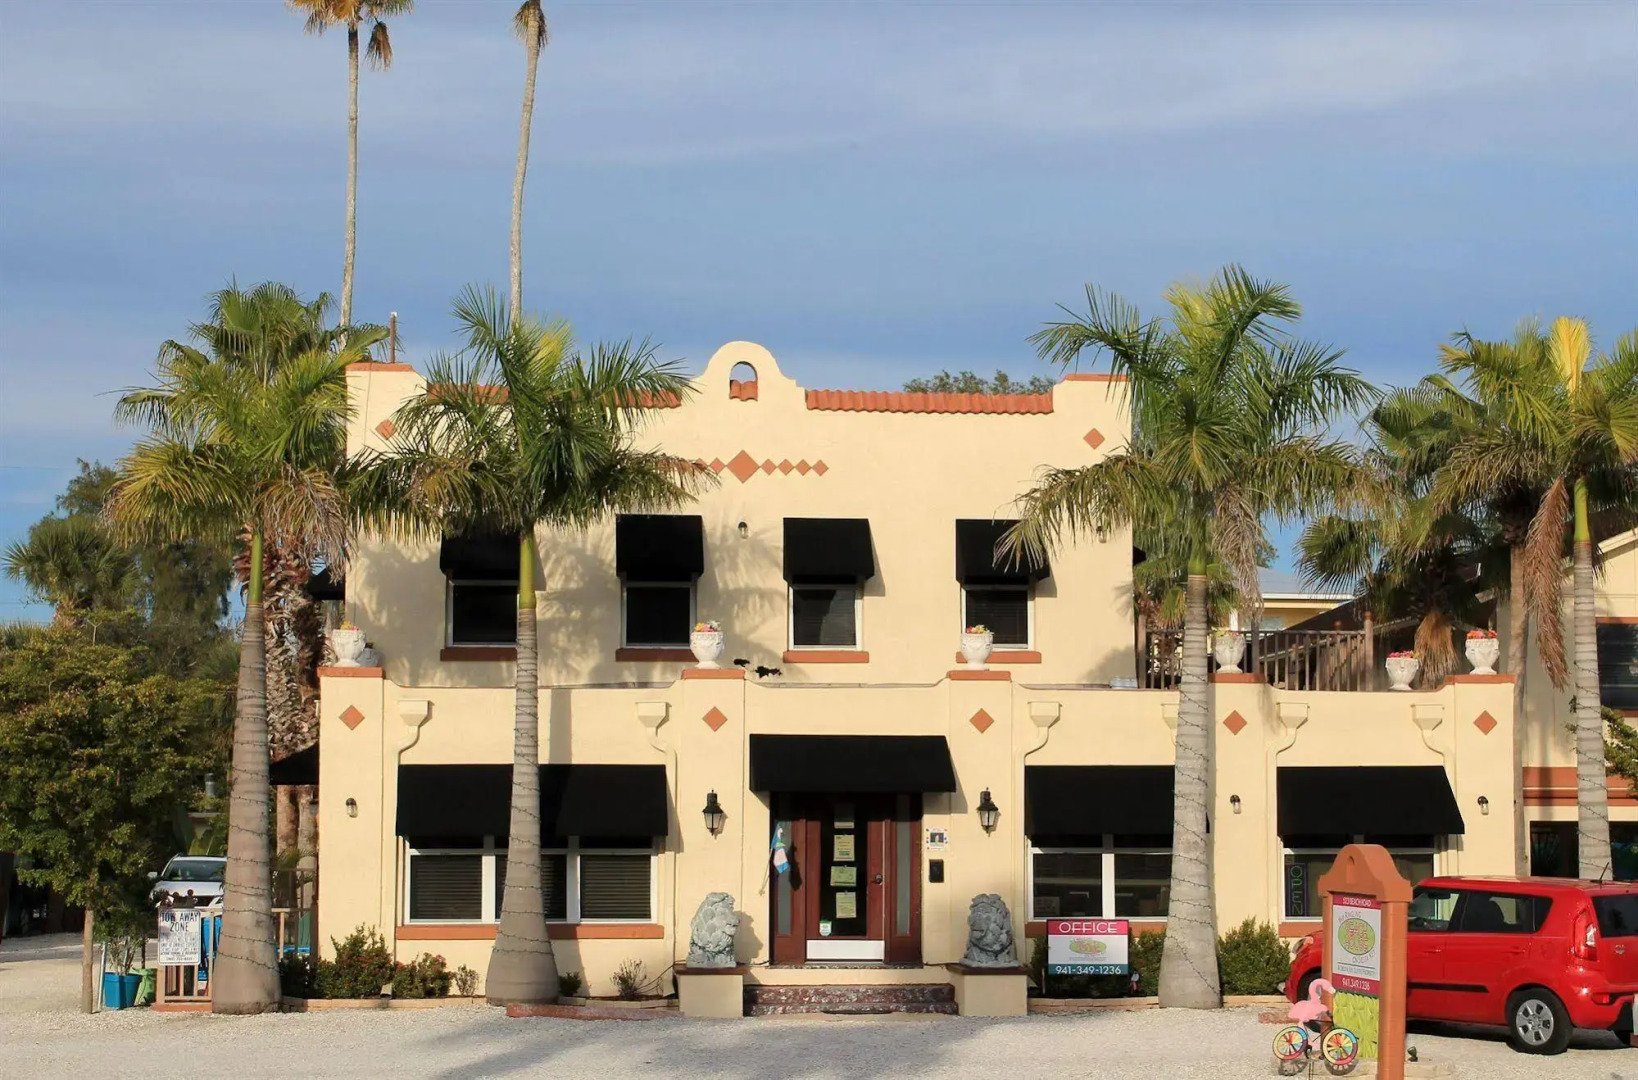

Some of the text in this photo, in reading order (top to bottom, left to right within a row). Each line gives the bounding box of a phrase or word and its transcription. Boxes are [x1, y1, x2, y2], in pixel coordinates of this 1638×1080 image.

[1290, 865, 1303, 915] OPEN
[160, 912, 199, 922] TOW AWAY
[169, 922, 188, 932] ZONE
[1058, 921, 1118, 933] OFFICE
[1055, 965, 1121, 975] 941-349-1236
